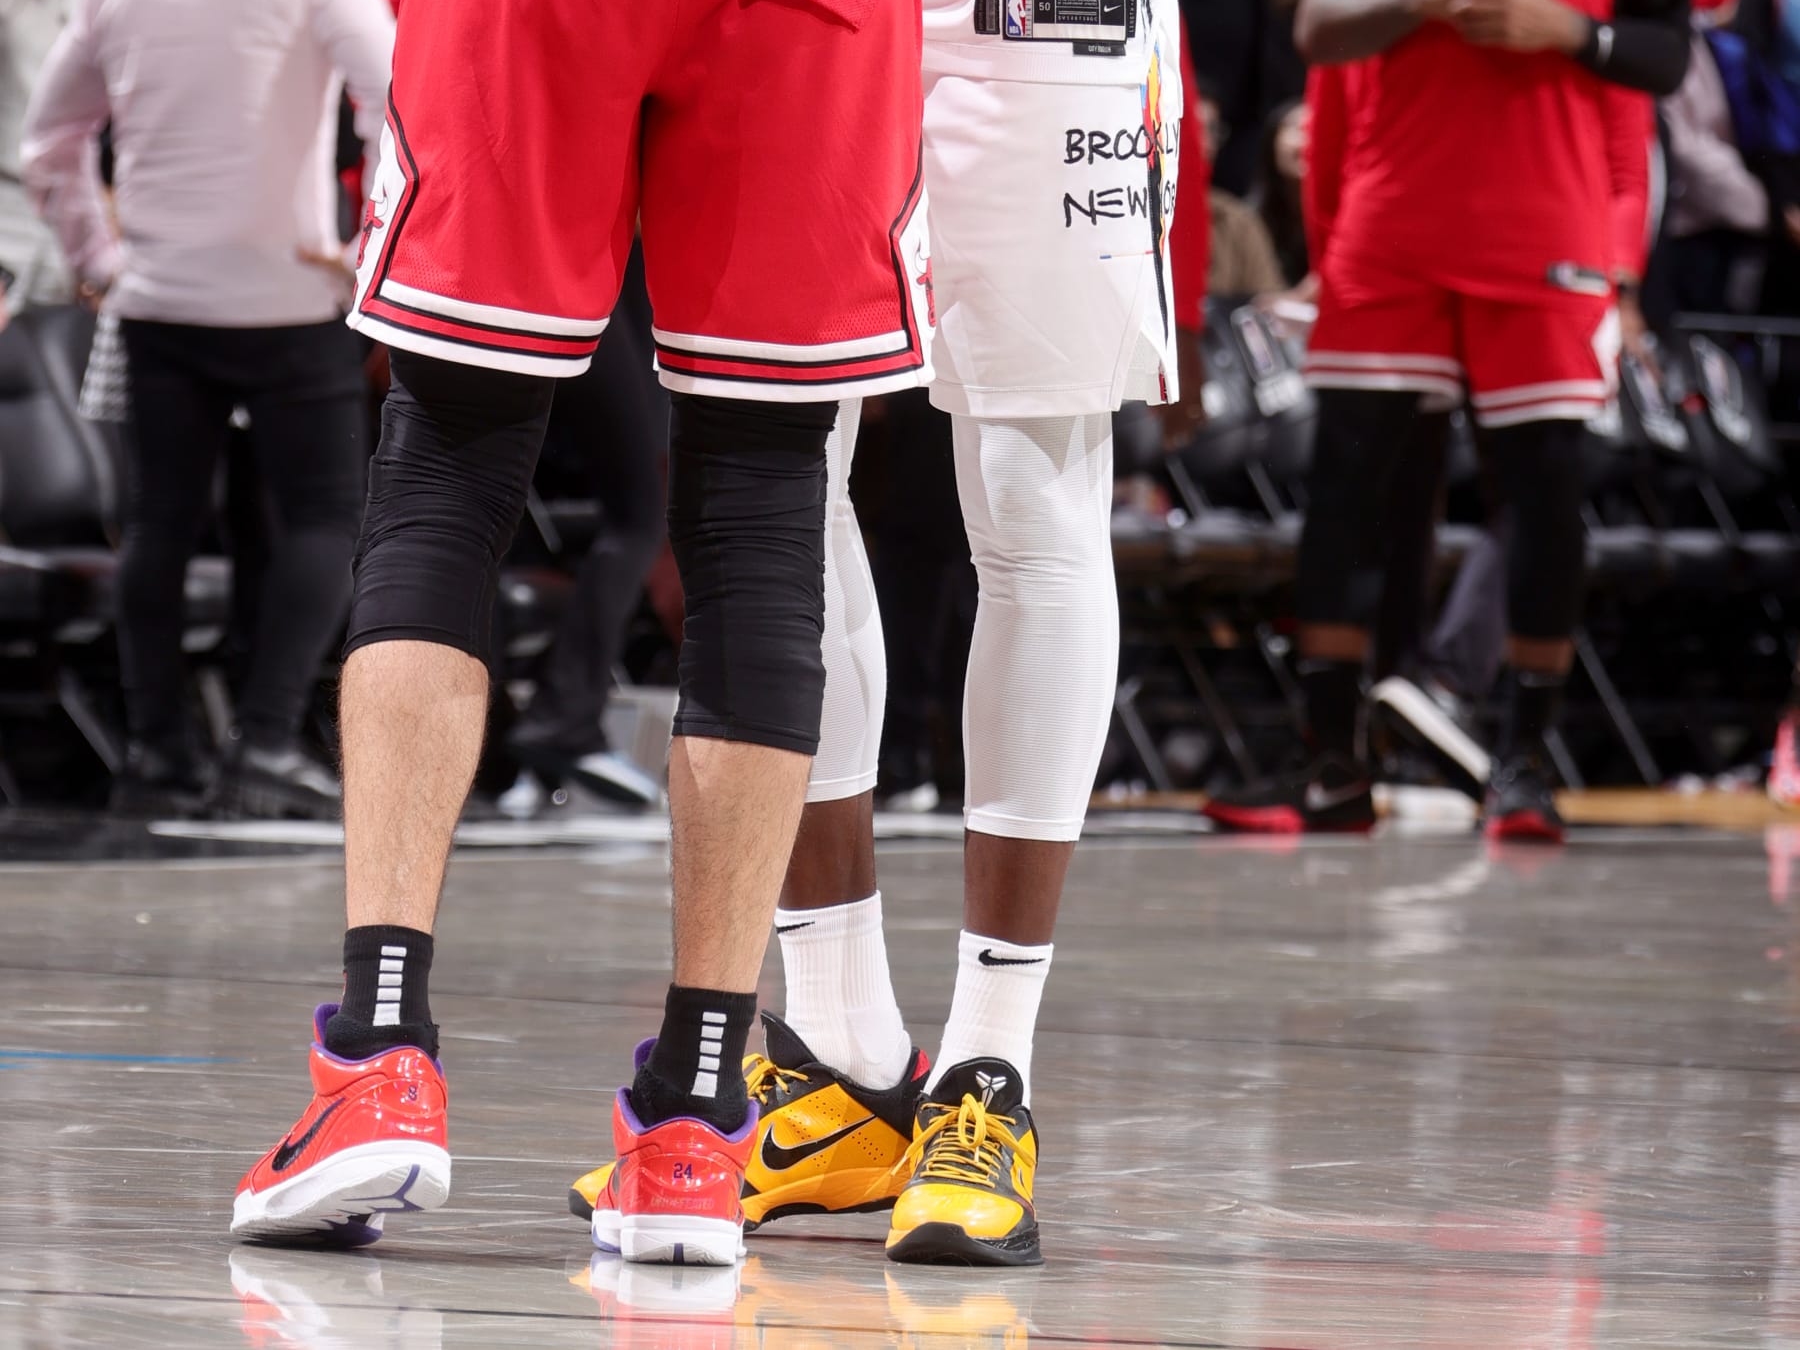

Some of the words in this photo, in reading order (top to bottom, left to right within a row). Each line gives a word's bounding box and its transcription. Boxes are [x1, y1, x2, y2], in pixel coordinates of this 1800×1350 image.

[1038, 2, 1051, 11] 50
[1064, 121, 1179, 165] BROOKLY
[1063, 185, 1148, 228] NEW
[673, 1162, 693, 1179] 24
